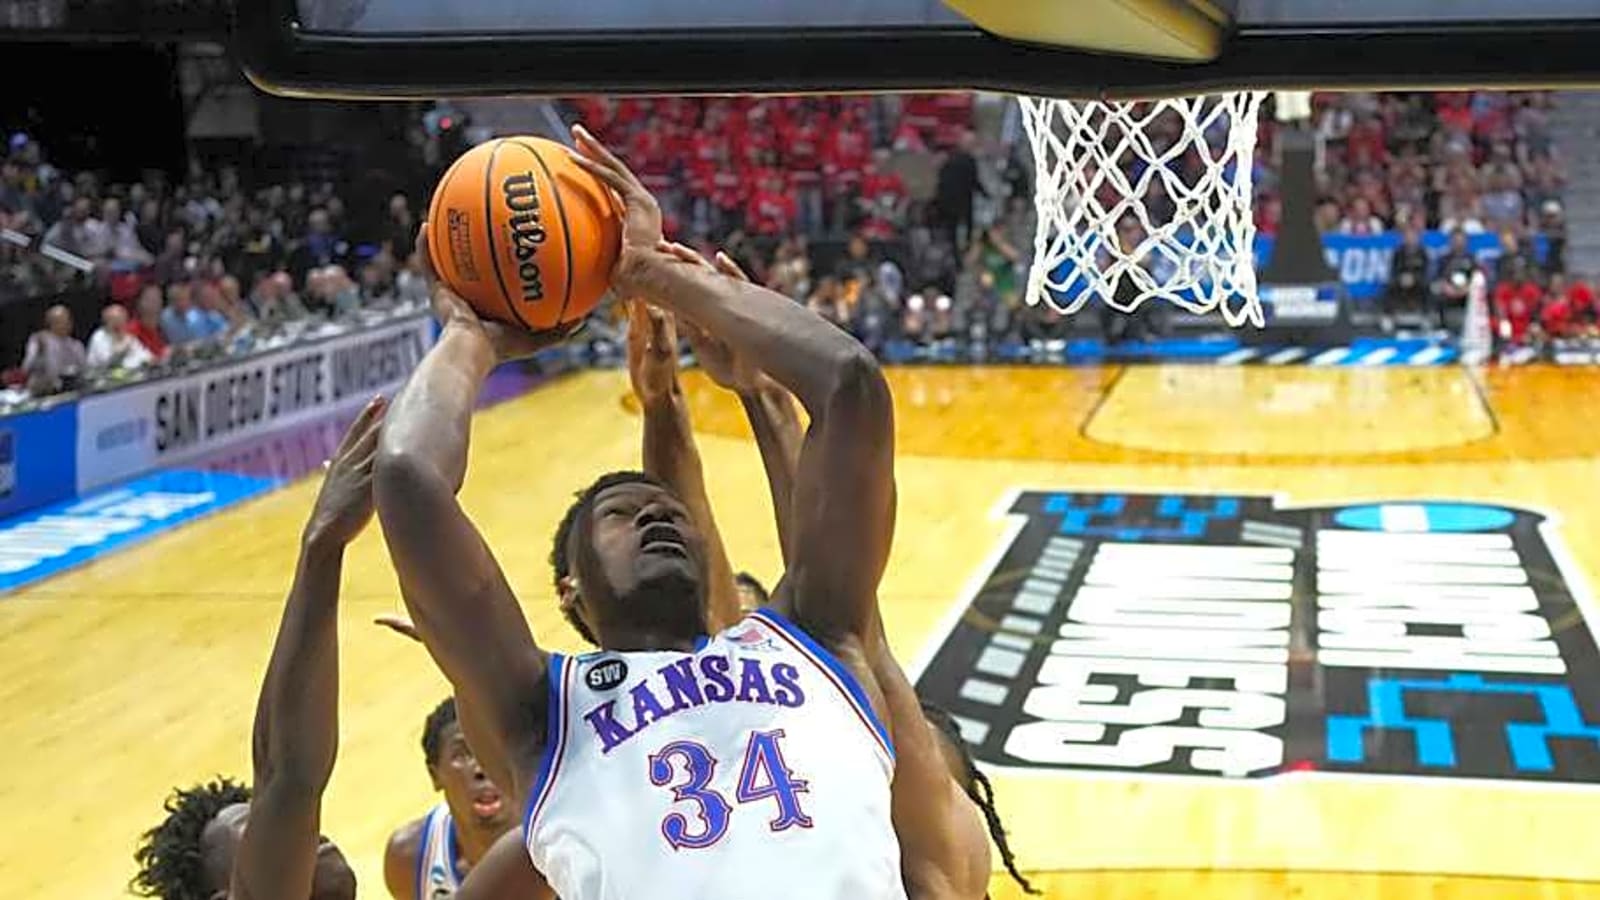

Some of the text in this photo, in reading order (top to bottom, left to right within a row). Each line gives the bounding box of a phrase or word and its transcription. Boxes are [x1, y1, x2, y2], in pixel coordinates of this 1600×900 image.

[503, 170, 546, 302] Wilson
[155, 387, 199, 452] SAN
[205, 368, 265, 438] DIEGO
[271, 353, 324, 416] STATE
[1002, 542, 1296, 777] MADNESS
[1316, 529, 1568, 674] MARCH
[584, 654, 806, 754] KANSAS
[589, 660, 623, 688] SW
[648, 728, 814, 850] 34
